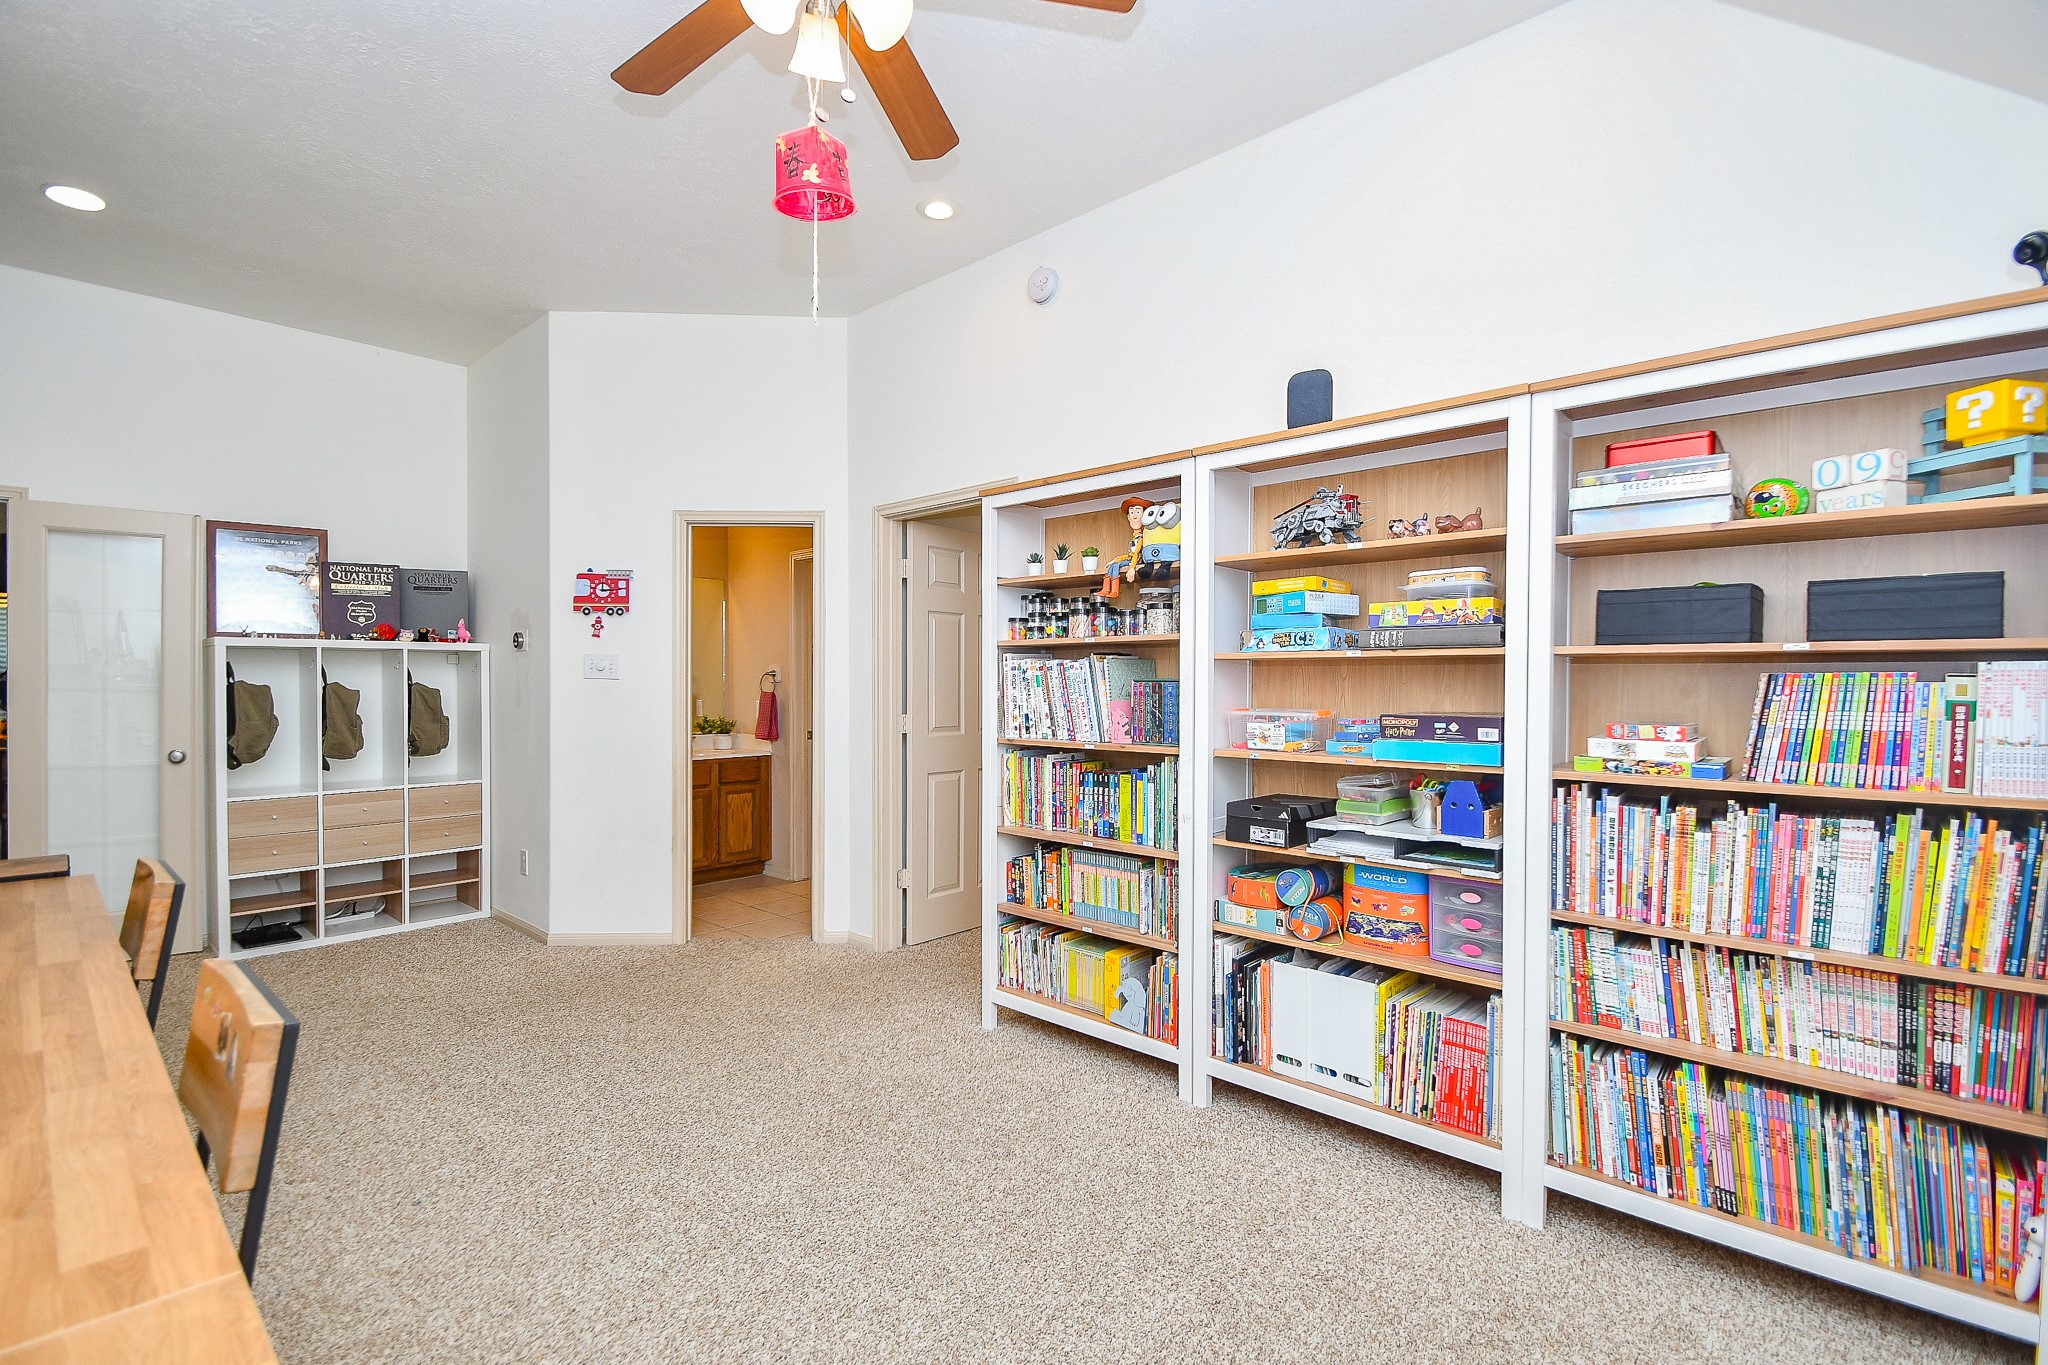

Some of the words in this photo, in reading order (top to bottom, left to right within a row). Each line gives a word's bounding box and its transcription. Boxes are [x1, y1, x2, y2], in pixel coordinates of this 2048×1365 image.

[1621, 477, 1678, 492] SKECHERS
[1819, 491, 1884, 513] years
[329, 564, 372, 574] NATIONAL
[373, 566, 394, 574] PARK
[328, 569, 394, 583] QUARTERS
[407, 575, 459, 586] QUARTERS
[1289, 631, 1315, 647] ICE
[1384, 727, 1398, 737] Harry
[1399, 728, 1416, 737] Potter
[1361, 872, 1408, 884] WORLD
